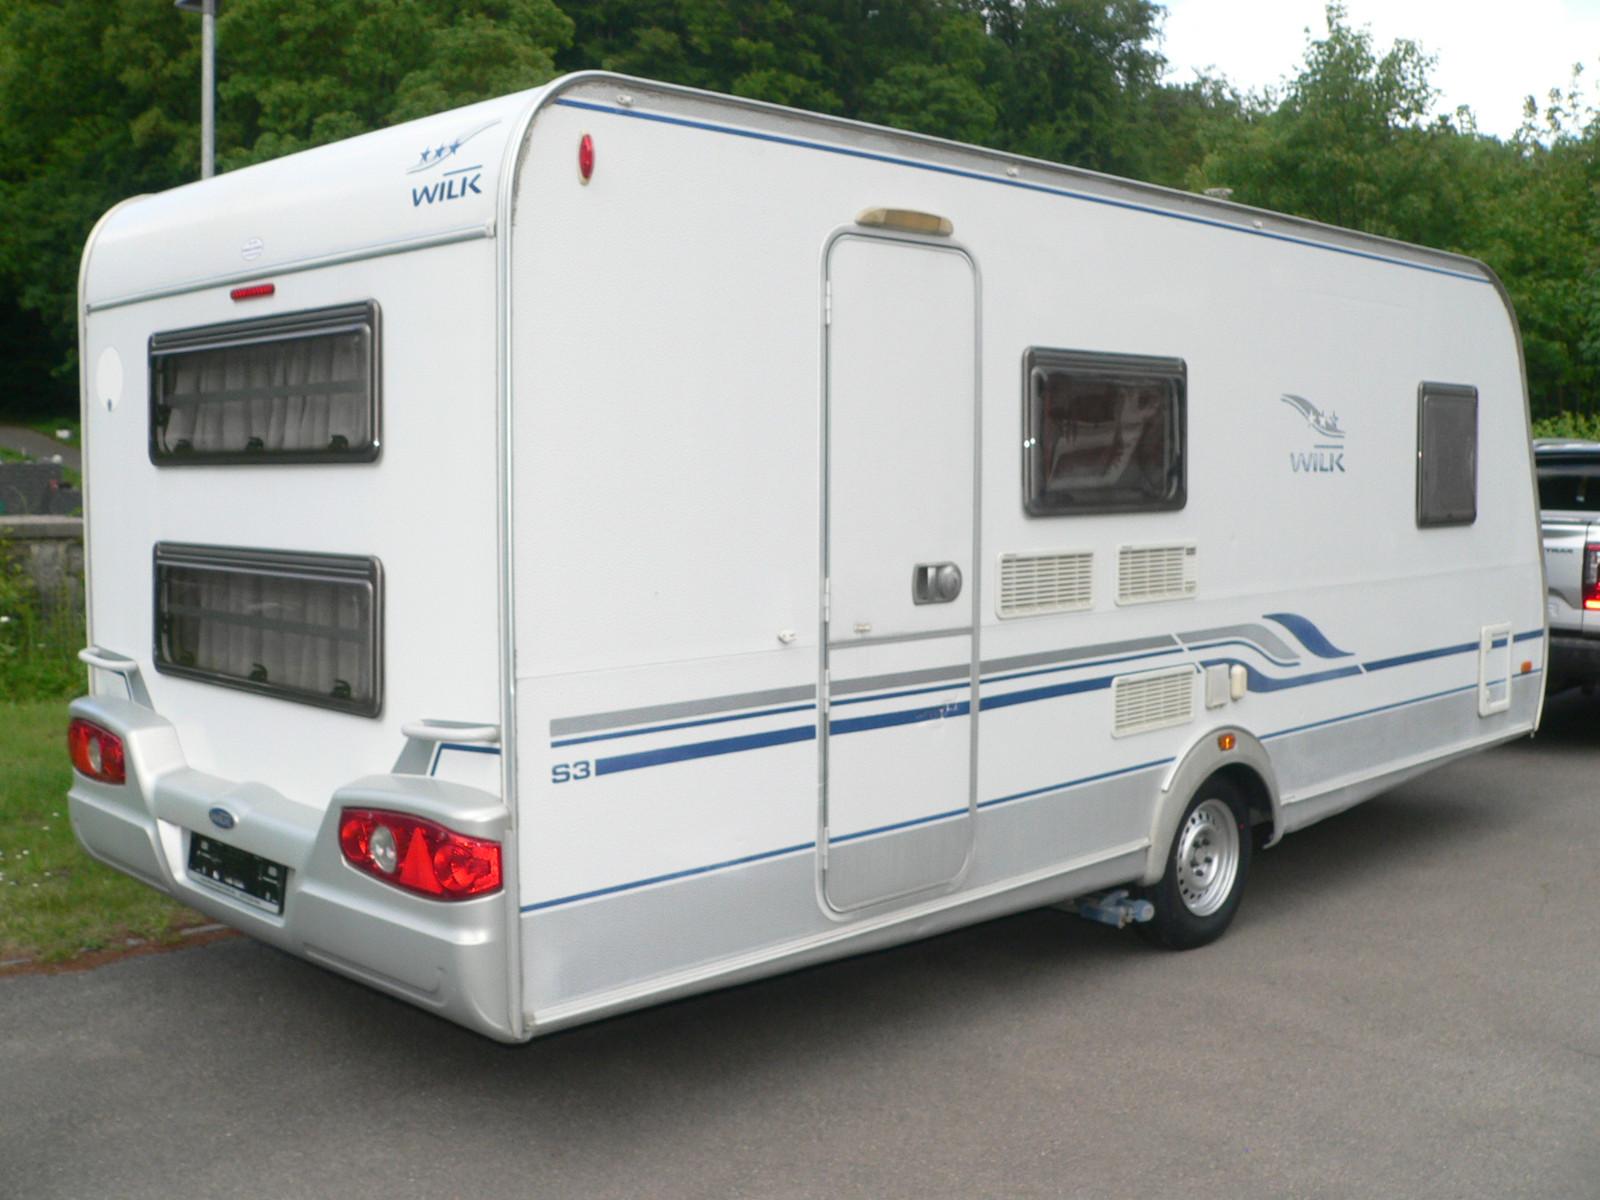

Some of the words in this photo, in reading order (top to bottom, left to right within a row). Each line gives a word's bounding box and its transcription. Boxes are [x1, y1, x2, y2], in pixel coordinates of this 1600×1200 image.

[412, 173, 482, 207] WILK
[1290, 452, 1345, 473] WILK
[551, 760, 591, 784] S3
